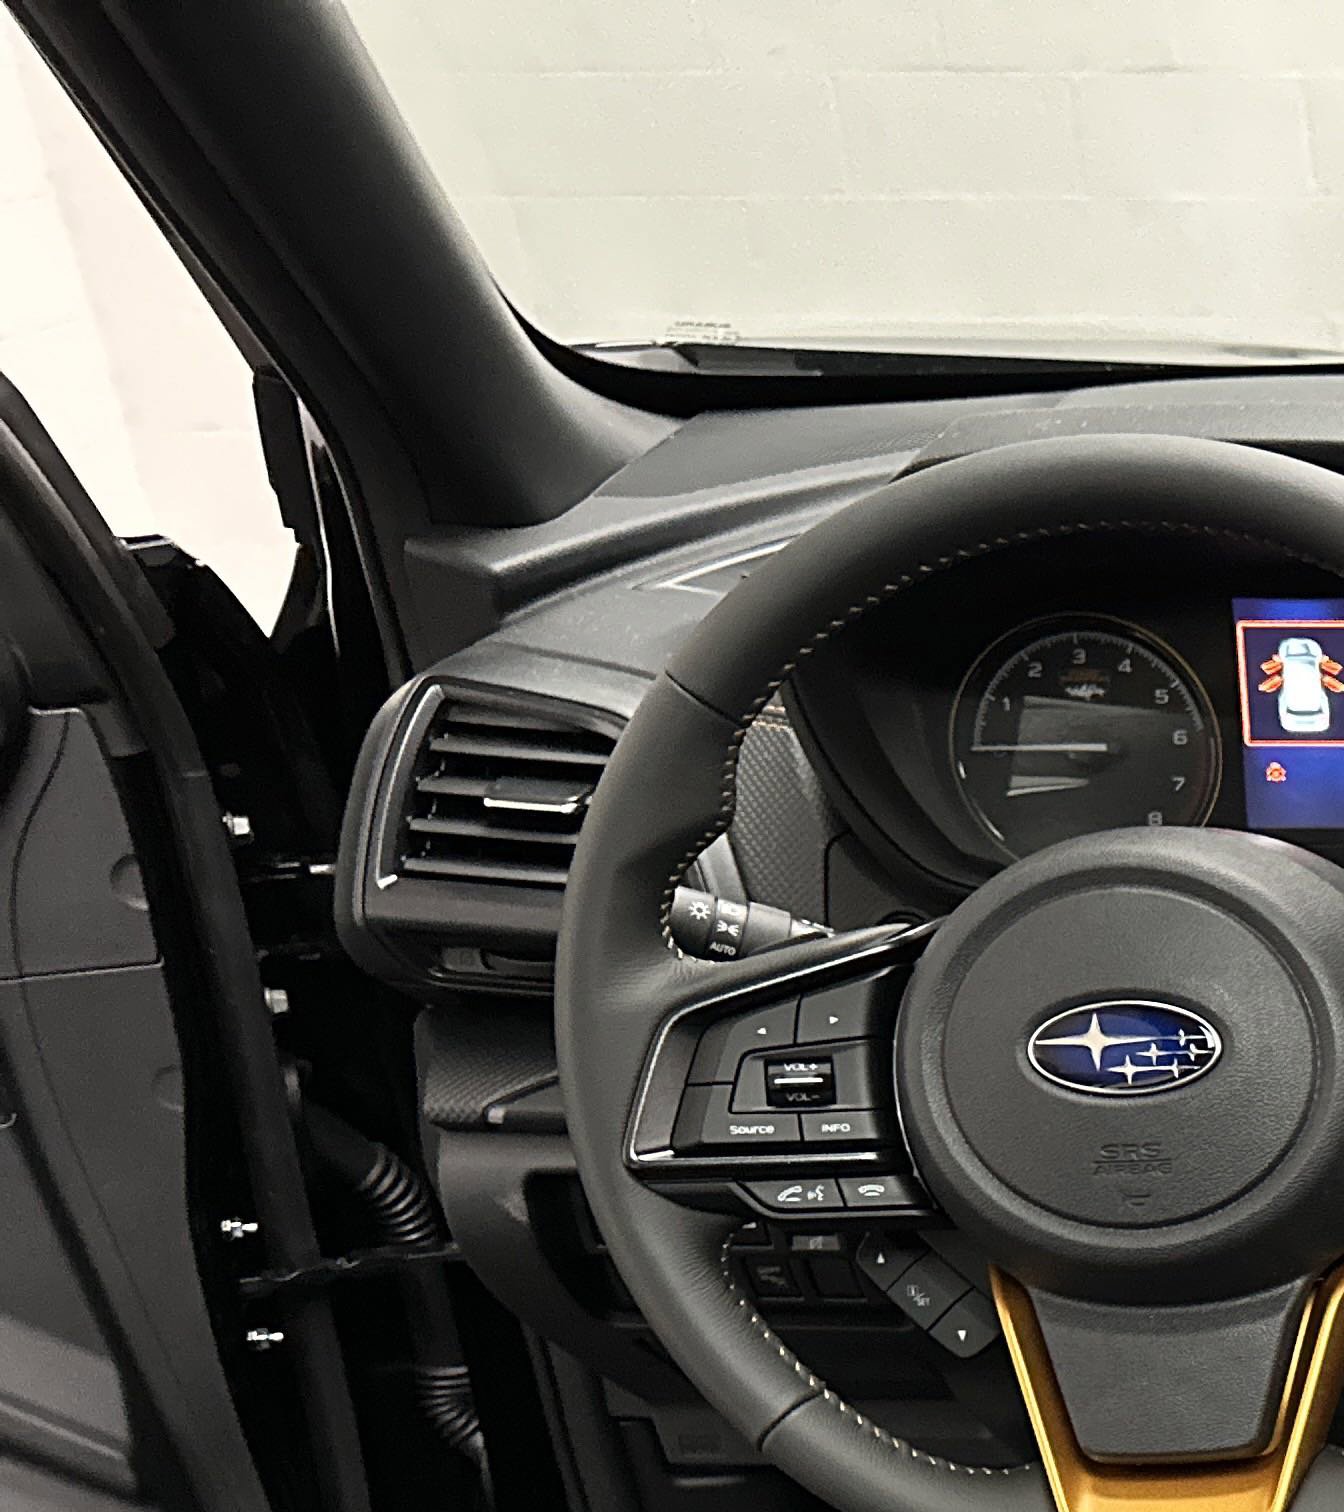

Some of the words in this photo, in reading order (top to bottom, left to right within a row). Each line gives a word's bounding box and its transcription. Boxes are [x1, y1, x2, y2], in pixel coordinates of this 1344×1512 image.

[1072, 649, 1086, 664] 3
[1027, 662, 1043, 678] 2
[1117, 659, 1133, 673] 4
[1002, 697, 1011, 711] 1
[1155, 689, 1169, 704] 5
[1173, 730, 1188, 745] 6
[1172, 777, 1186, 791] 7
[1148, 812, 1163, 826] 8
[710, 941, 737, 957] AUTO
[821, 1121, 851, 1134] INFO
[1100, 1142, 1162, 1159] SRS
